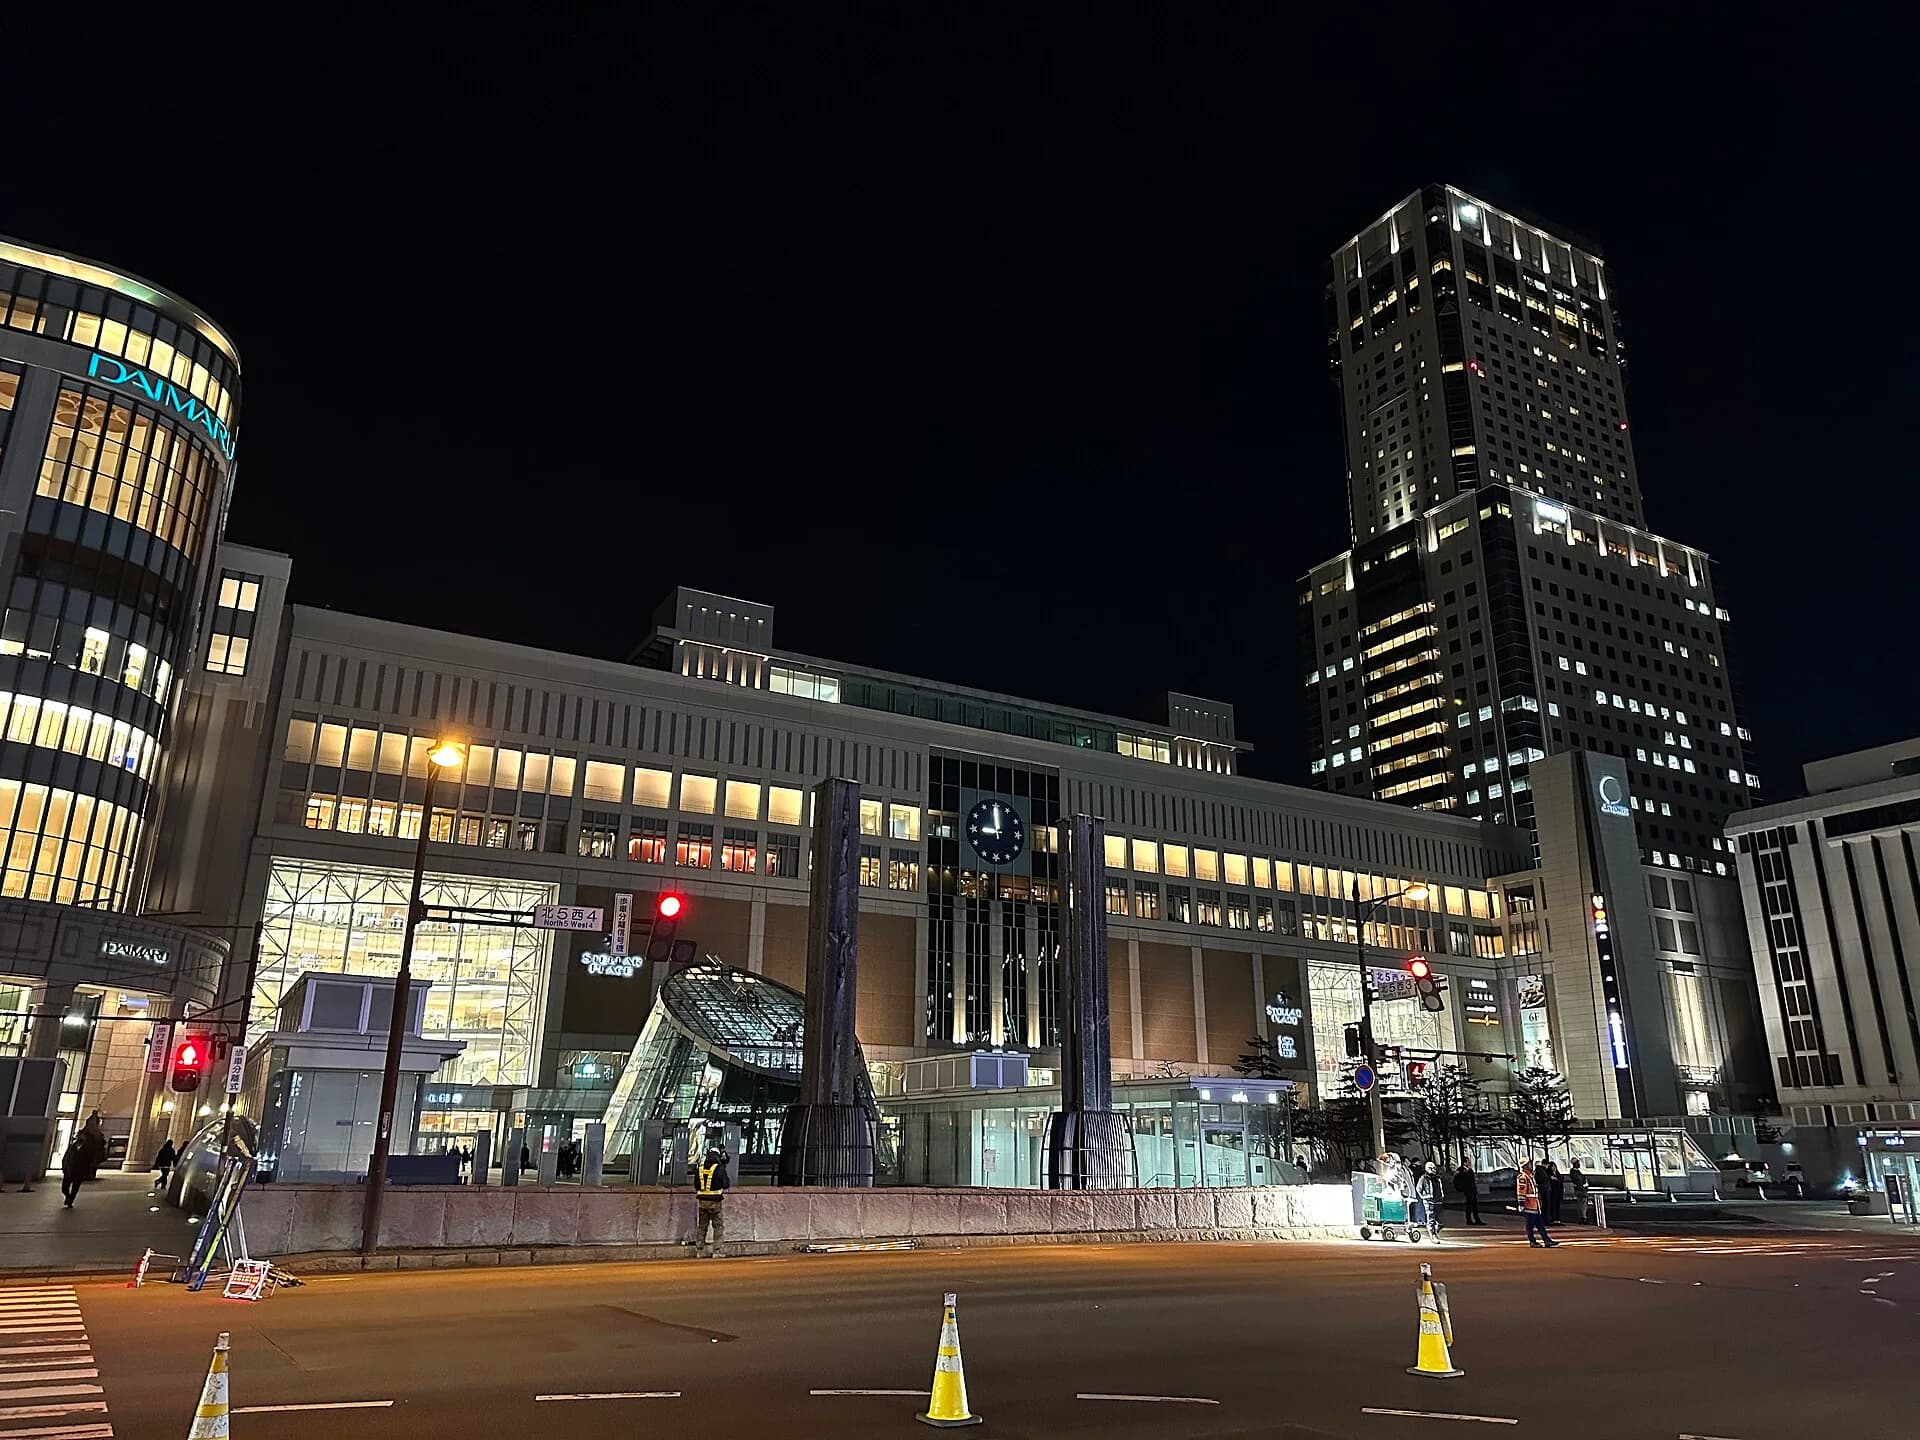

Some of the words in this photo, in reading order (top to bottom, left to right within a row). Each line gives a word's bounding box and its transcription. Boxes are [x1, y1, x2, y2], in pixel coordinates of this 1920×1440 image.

[87, 352, 236, 460] DAIMARU
[542, 906, 597, 922] 北5西4
[103, 941, 170, 964] DAIMARU
[1528, 1012, 1540, 1022] 6F
